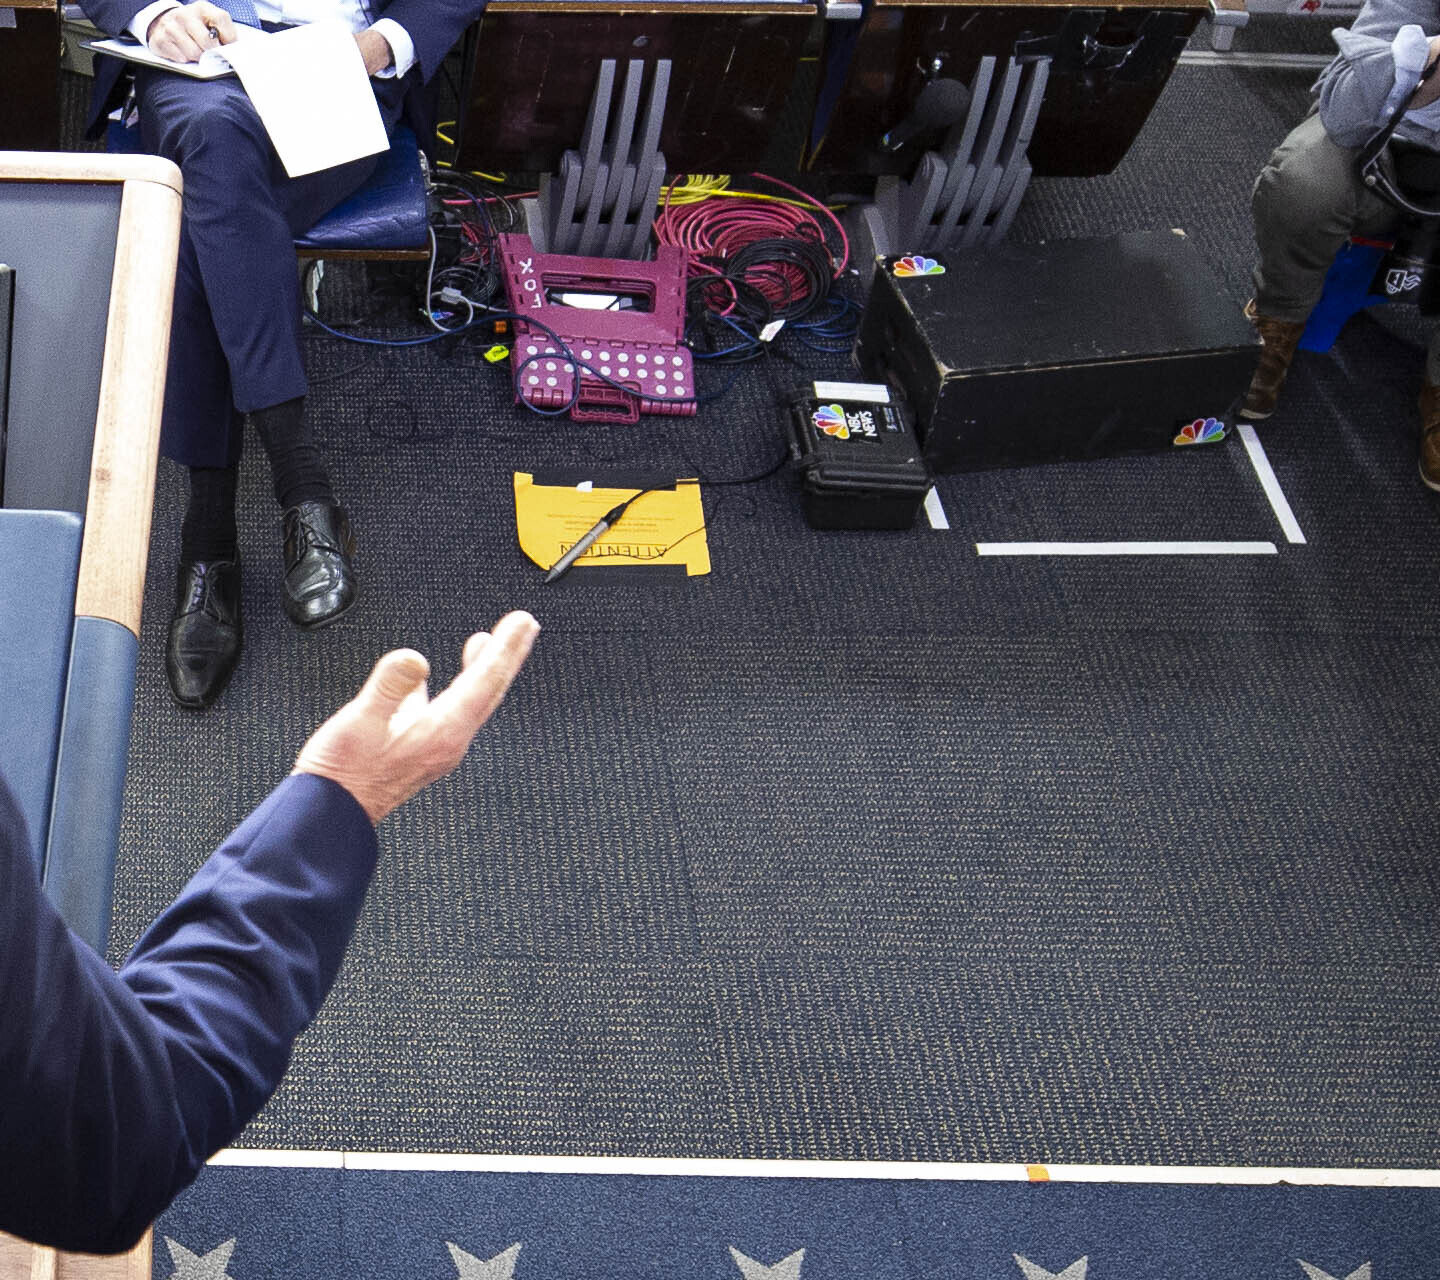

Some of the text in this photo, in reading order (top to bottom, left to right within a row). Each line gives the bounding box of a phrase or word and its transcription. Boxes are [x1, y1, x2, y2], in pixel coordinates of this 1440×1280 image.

[519, 258, 542, 308] FOX
[846, 412, 863, 433] NBC
[859, 411, 878, 437] NEWS
[560, 543, 669, 557] ATTENTIN
